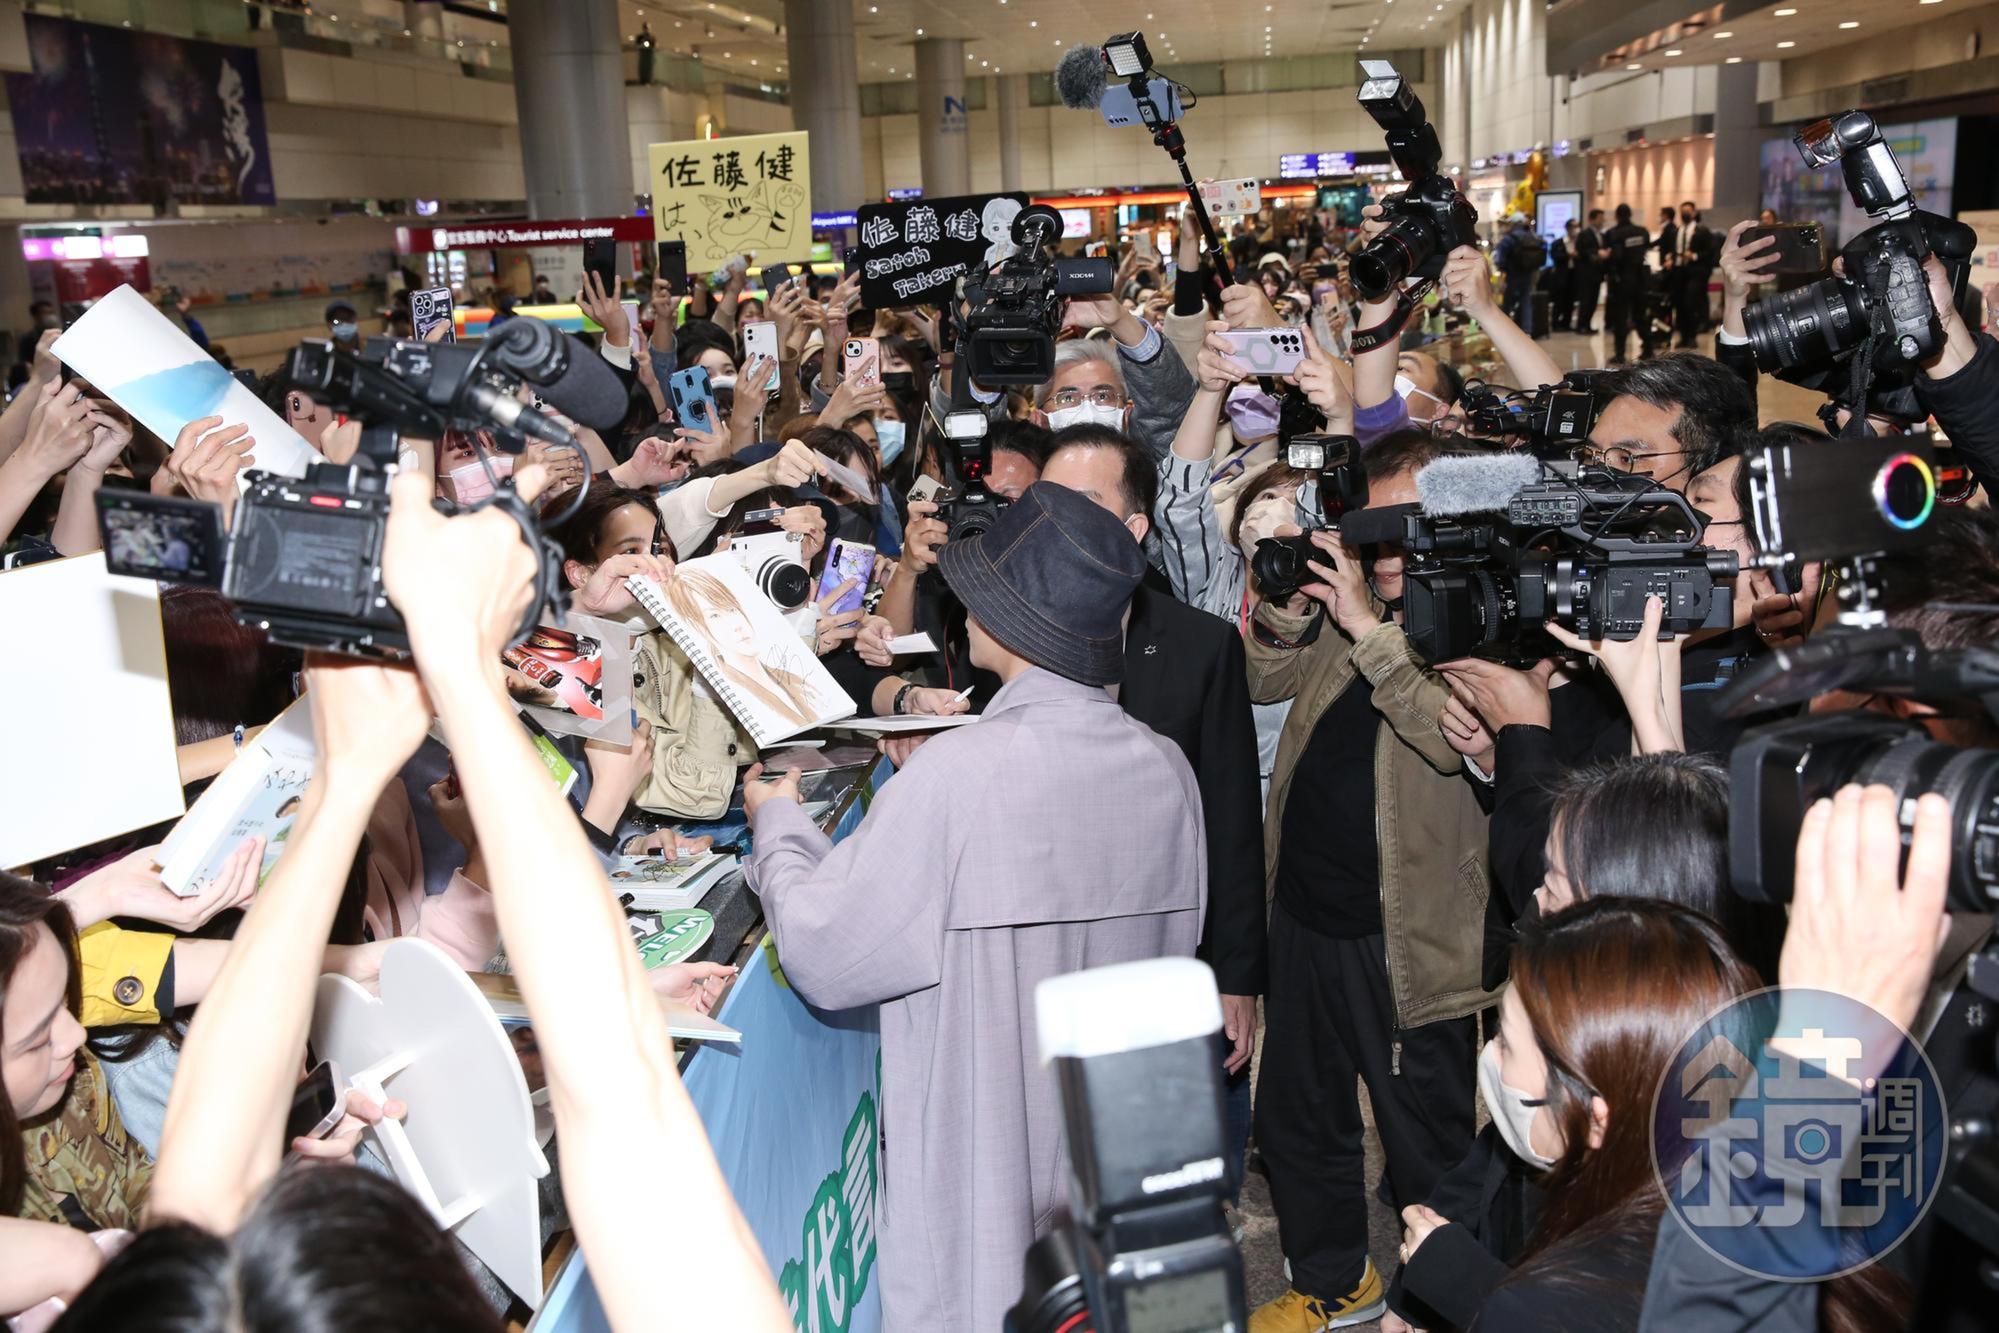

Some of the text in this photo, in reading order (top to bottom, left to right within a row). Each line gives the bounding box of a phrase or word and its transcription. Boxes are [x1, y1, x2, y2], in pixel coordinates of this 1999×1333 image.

[662, 144, 796, 192] 佐藤健
[506, 229, 541, 242] Tourist
[542, 227, 579, 240] service
[580, 226, 614, 239] center
[861, 205, 980, 249] 佐藤健
[1562, 410, 1575, 419] 4K
